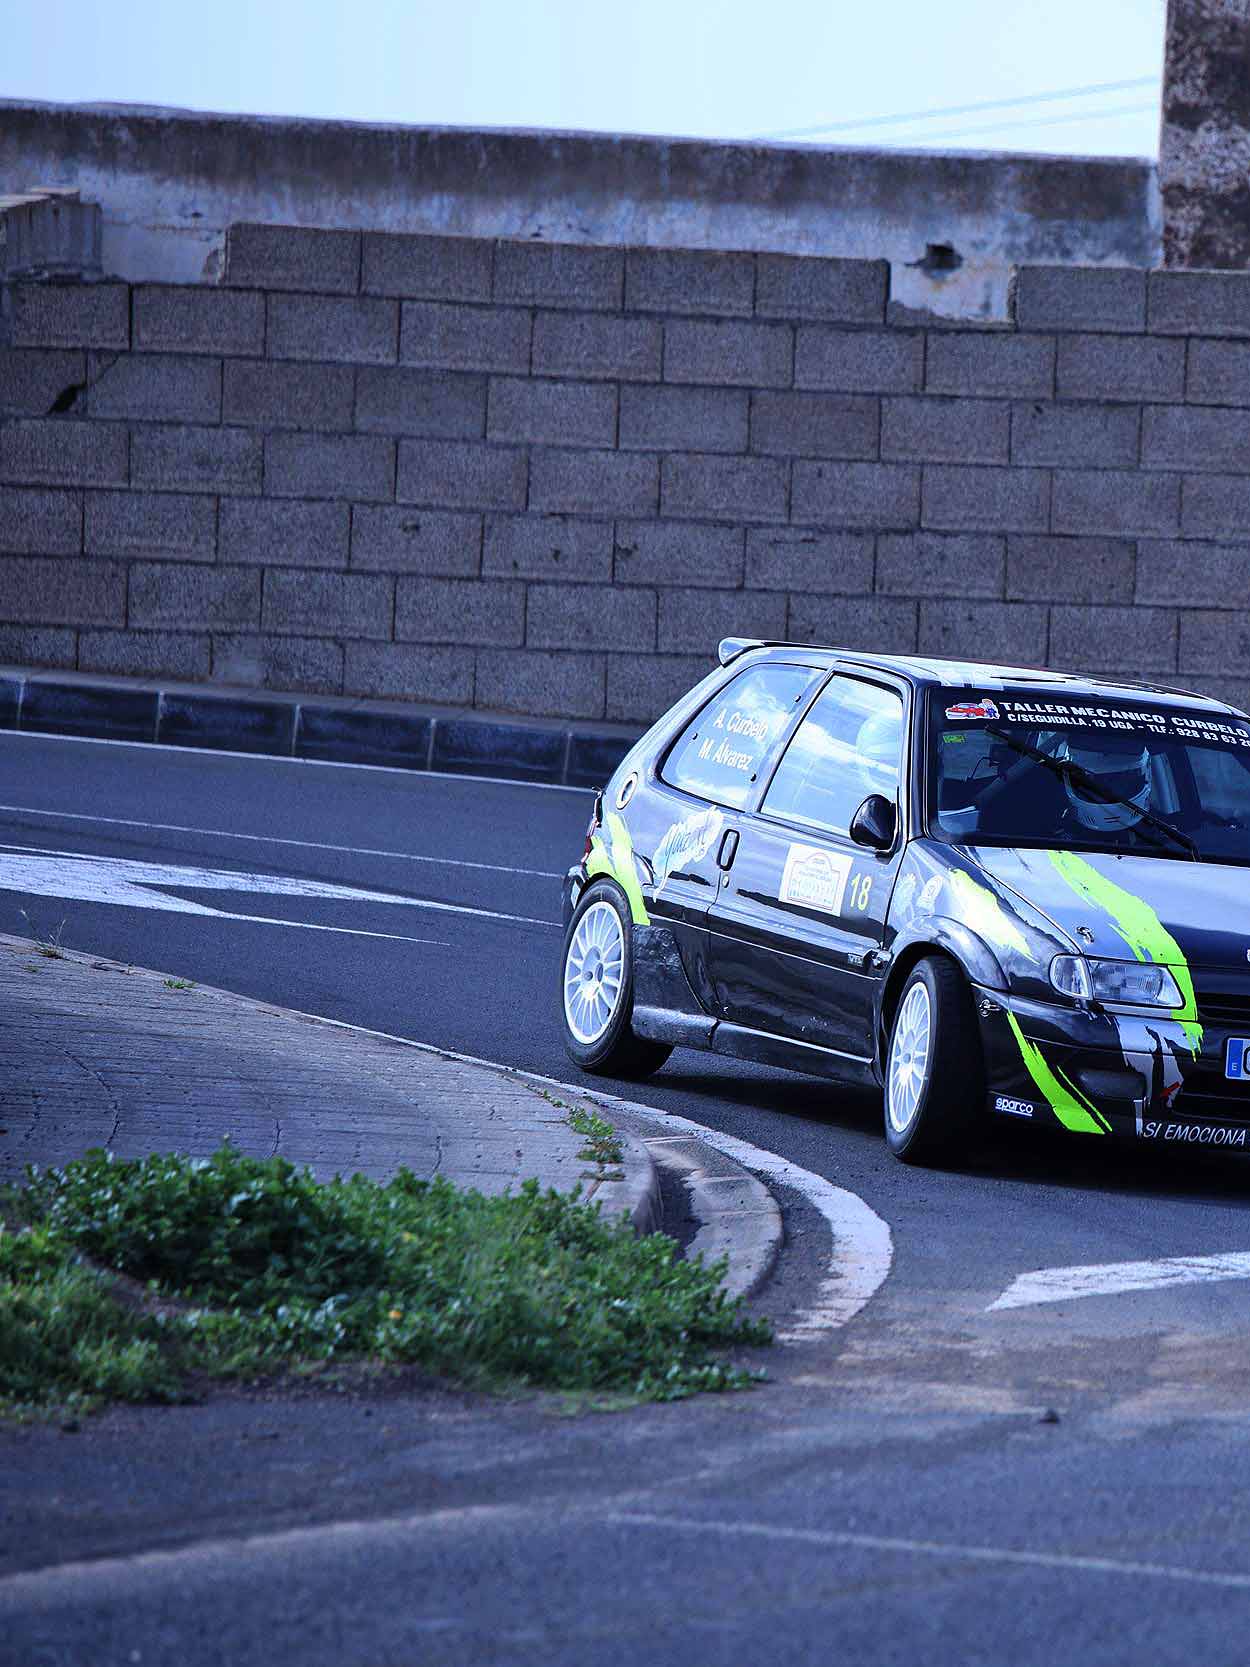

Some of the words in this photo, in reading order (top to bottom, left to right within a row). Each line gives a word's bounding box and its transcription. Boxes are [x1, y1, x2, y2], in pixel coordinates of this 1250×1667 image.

[999, 702, 1069, 714] TALLER
[1070, 706, 1165, 724] MECANICO
[1171, 717, 1249, 738] CURBELO
[1109, 720, 1135, 730] UGA
[1176, 727, 1200, 738] 928
[1202, 731, 1219, 741] 83
[850, 872, 872, 911] 18
[995, 1097, 1034, 1117] sparco
[1143, 1122, 1163, 1138] SI
[1164, 1124, 1247, 1146] EMOCIONA
